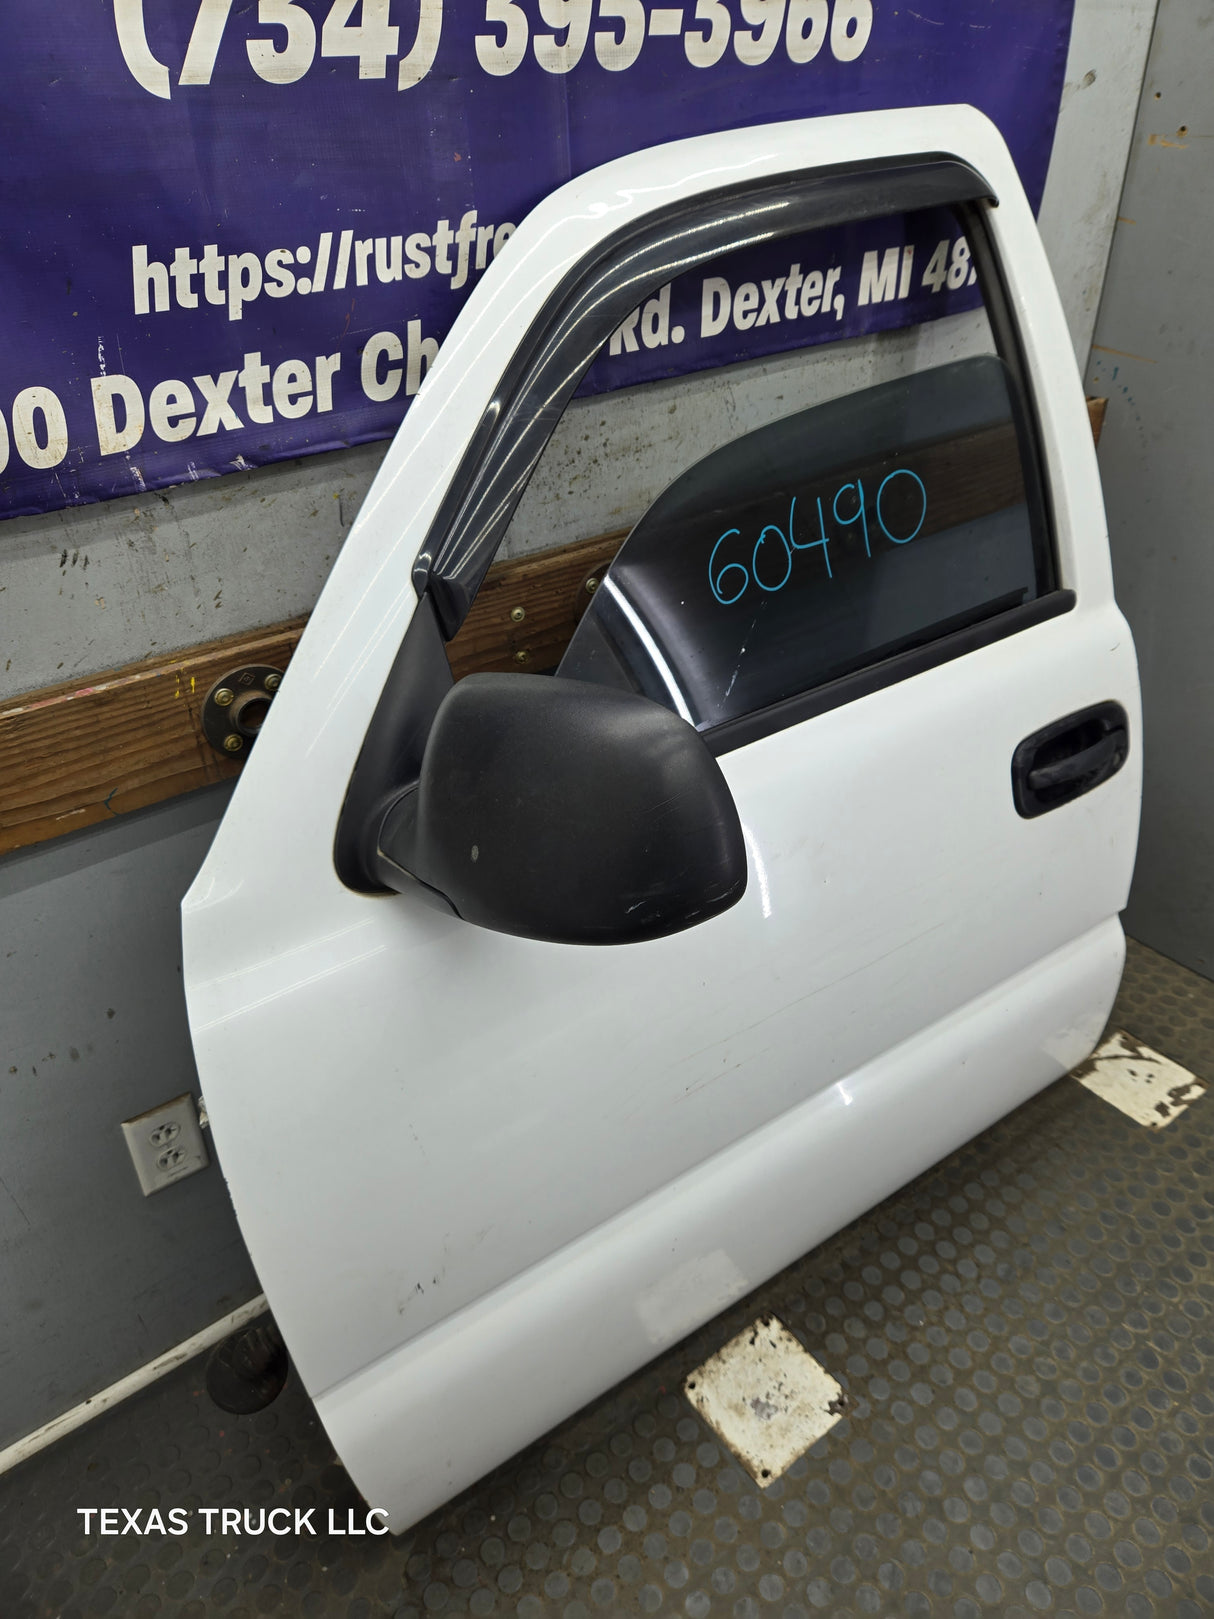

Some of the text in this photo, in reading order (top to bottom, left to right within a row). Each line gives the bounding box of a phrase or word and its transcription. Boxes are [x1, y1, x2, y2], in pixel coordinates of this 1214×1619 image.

[91, 351, 341, 456] Dexter
[361, 319, 440, 402] Ch
[700, 262, 845, 338] Dexter,
[858, 245, 915, 307] MI
[708, 469, 927, 604] 60490
